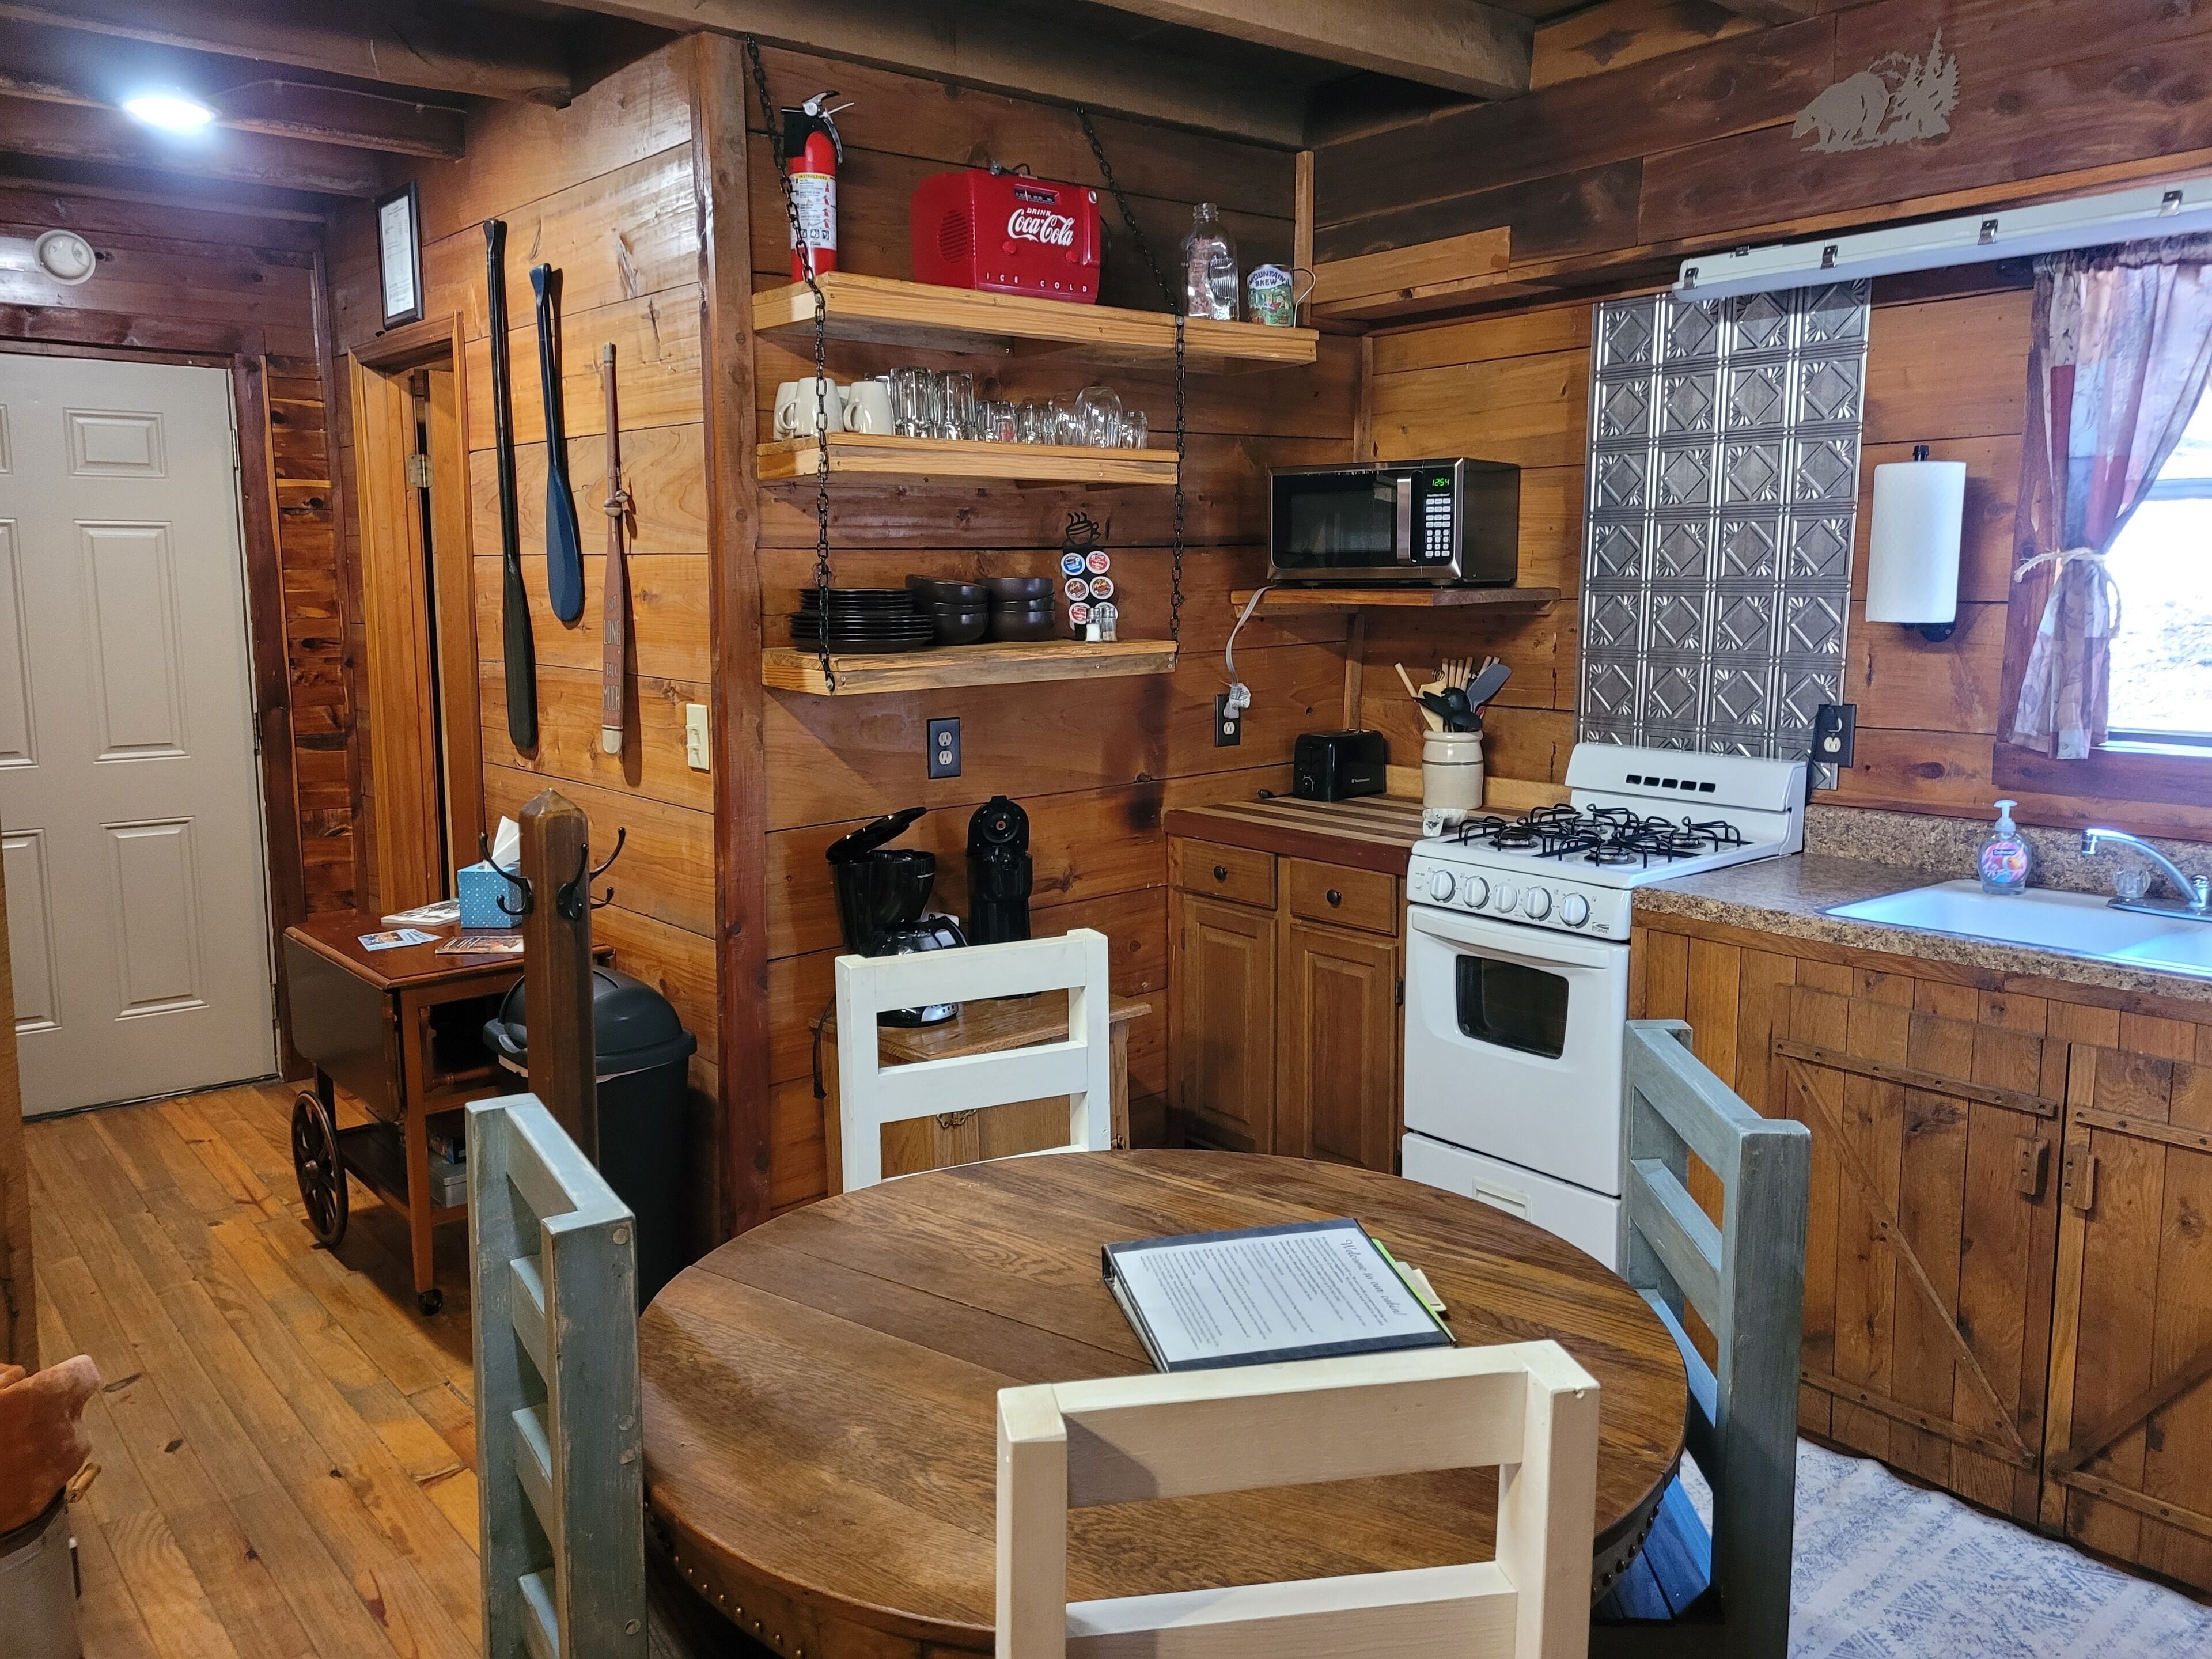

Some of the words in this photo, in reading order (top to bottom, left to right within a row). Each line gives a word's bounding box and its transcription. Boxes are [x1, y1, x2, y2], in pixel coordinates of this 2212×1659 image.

[1026, 207, 1051, 217] DRINK
[1007, 209, 1075, 246] Coca-Cola
[986, 272, 1018, 284] ICE
[1040, 280, 1088, 293] COLD
[1249, 271, 1286, 285] MOUNTAIN
[1255, 279, 1277, 287] BREW
[608, 595, 616, 610] SIT
[604, 619, 620, 646] LONG
[605, 663, 618, 677] TALK
[603, 685, 620, 711] MUCH
[1340, 1239, 1367, 1271] Welcome
[1370, 1282, 1384, 1293] our
[1381, 1296, 1407, 1316] cabin!
